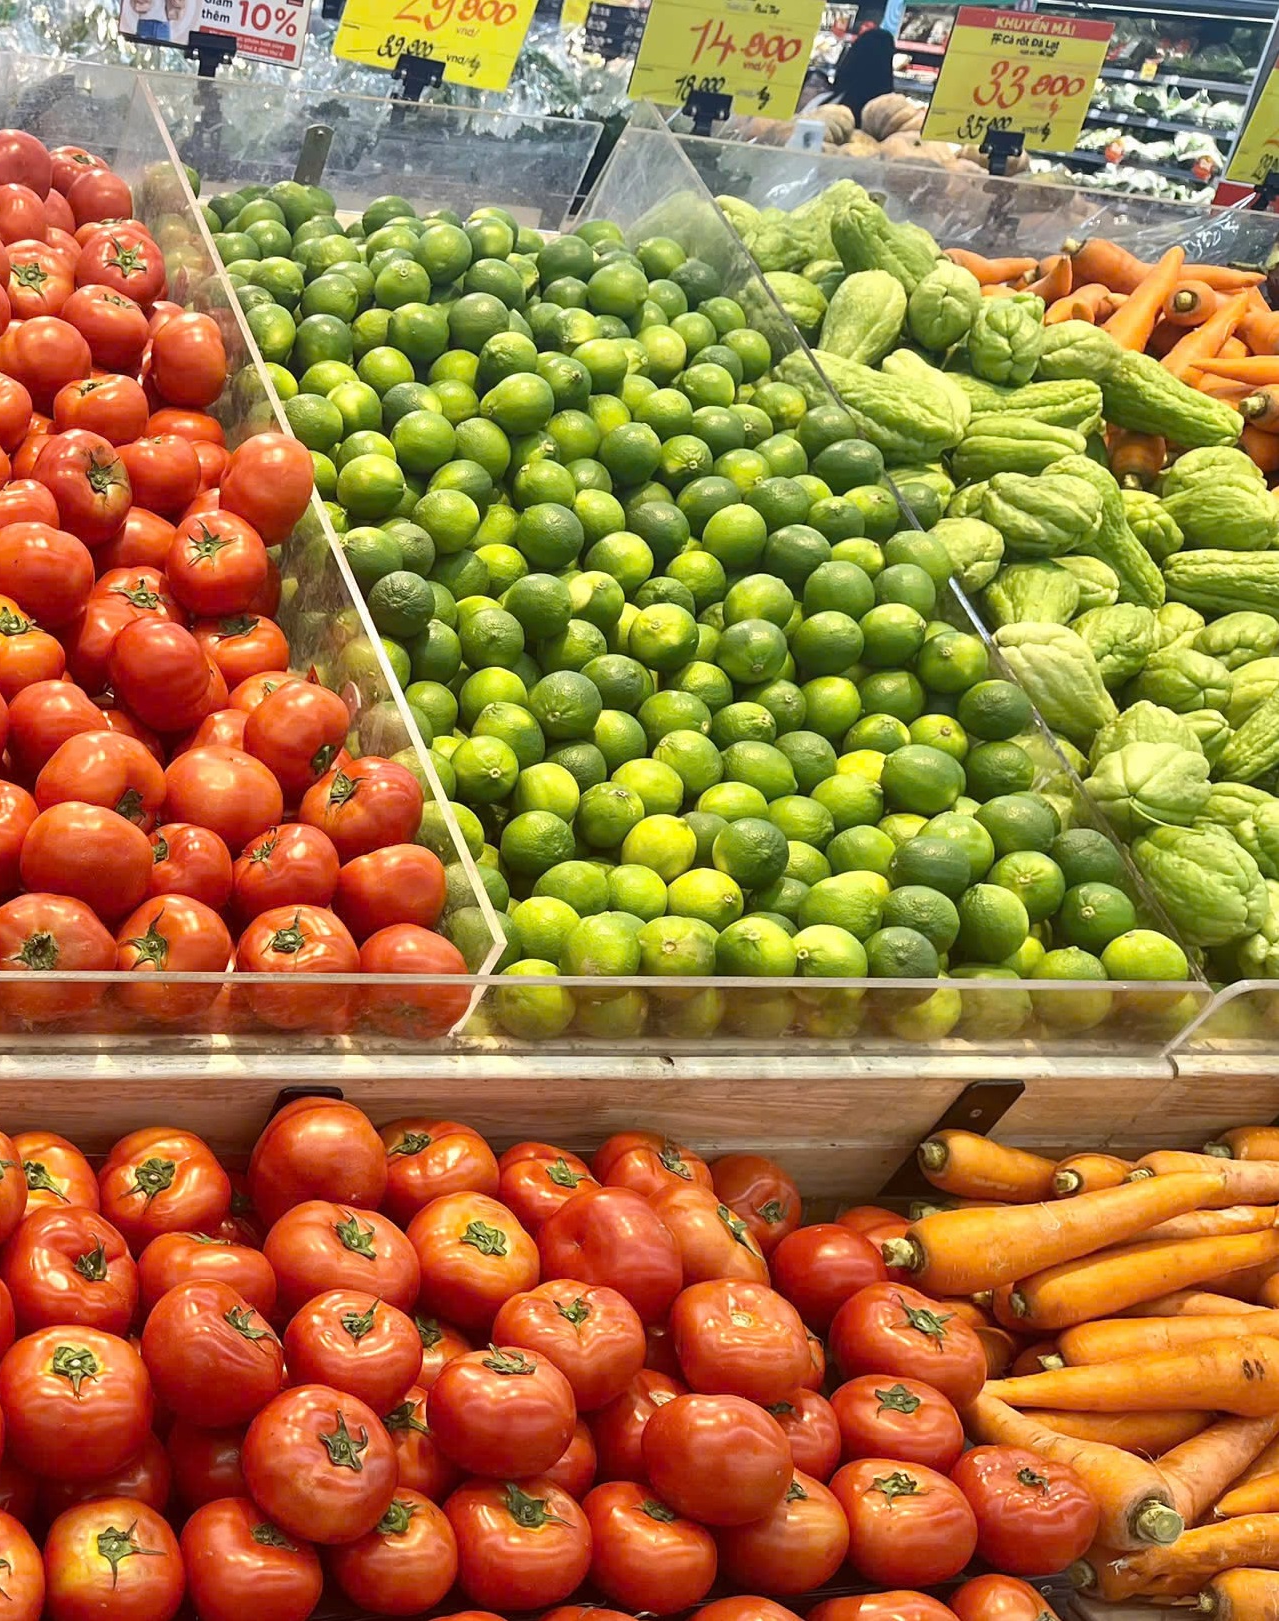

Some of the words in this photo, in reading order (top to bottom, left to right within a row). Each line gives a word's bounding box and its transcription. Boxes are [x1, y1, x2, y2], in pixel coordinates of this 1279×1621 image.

[202, 8, 231, 24] thêm
[239, 0, 297, 37] 10%
[995, 15, 1050, 33] KHUYẾN
